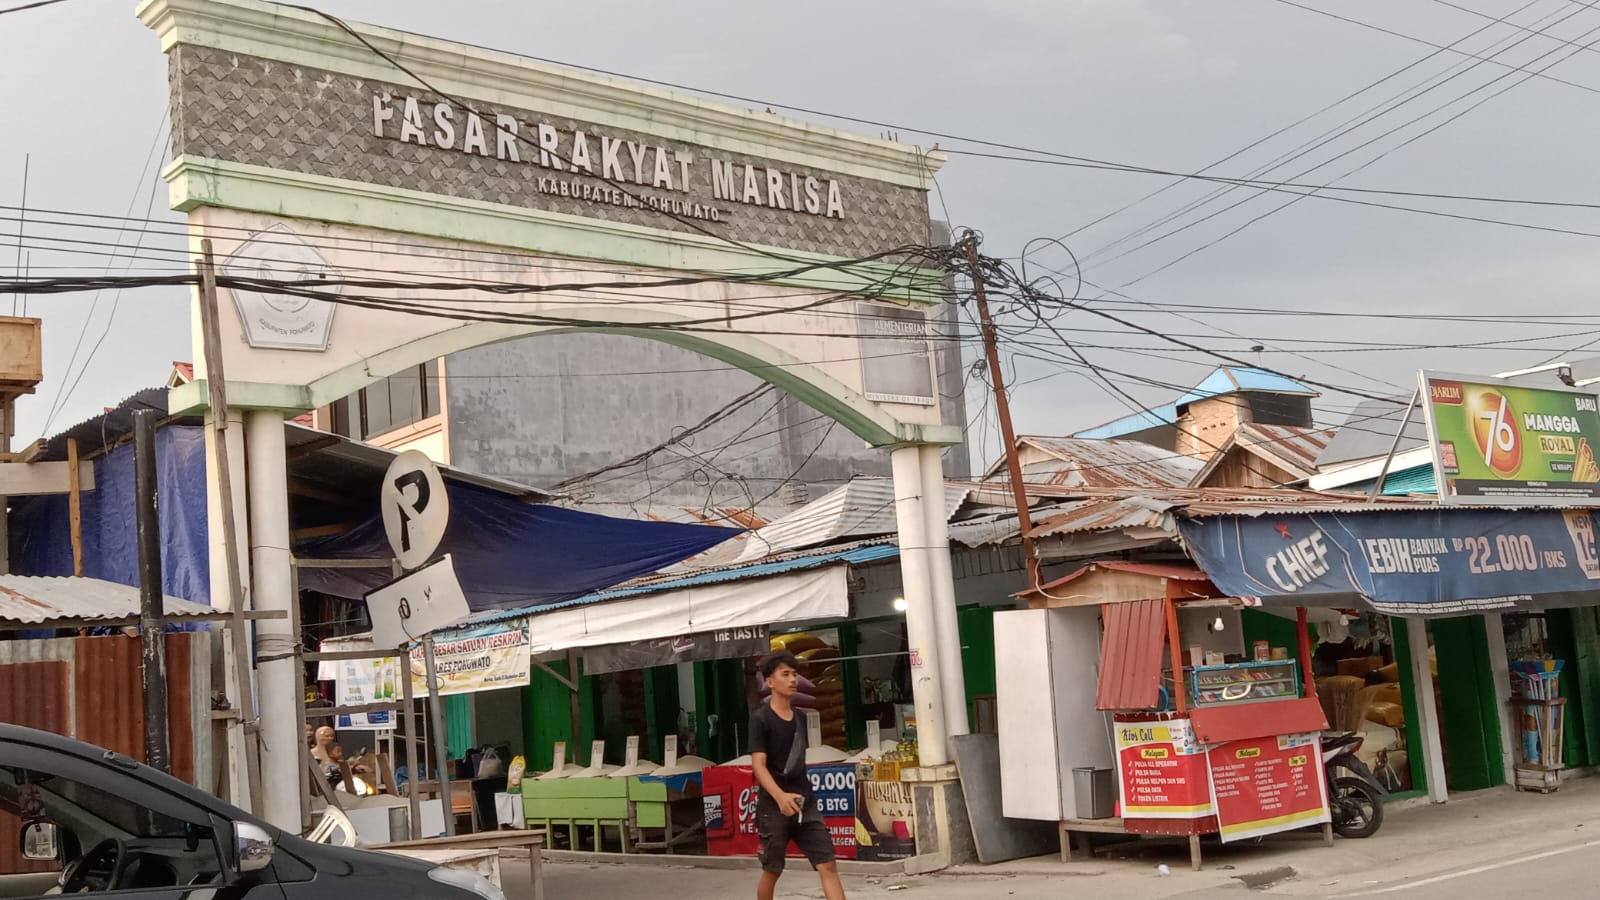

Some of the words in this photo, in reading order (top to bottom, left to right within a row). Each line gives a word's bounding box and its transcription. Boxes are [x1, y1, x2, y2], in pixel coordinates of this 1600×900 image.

[373, 93, 521, 162] PASAR
[538, 123, 693, 193] RAKYAT
[711, 158, 845, 219] MARISA
[538, 177, 632, 208] KABUPATEN
[1575, 397, 1597, 412] BARU
[1480, 395, 1515, 468] 76
[1524, 413, 1581, 433] MANGGA
[1541, 437, 1574, 452] ROYAL
[1357, 538, 1414, 573] LEBIH
[1410, 538, 1448, 555] BANYAK
[1465, 534, 1538, 574] 22.000
[1266, 529, 1330, 592] CHIEF
[1413, 557, 1440, 573] PUAS
[457, 636, 487, 652] SATUAN
[807, 771, 856, 791] 9.000
[826, 798, 849, 812] BTG
